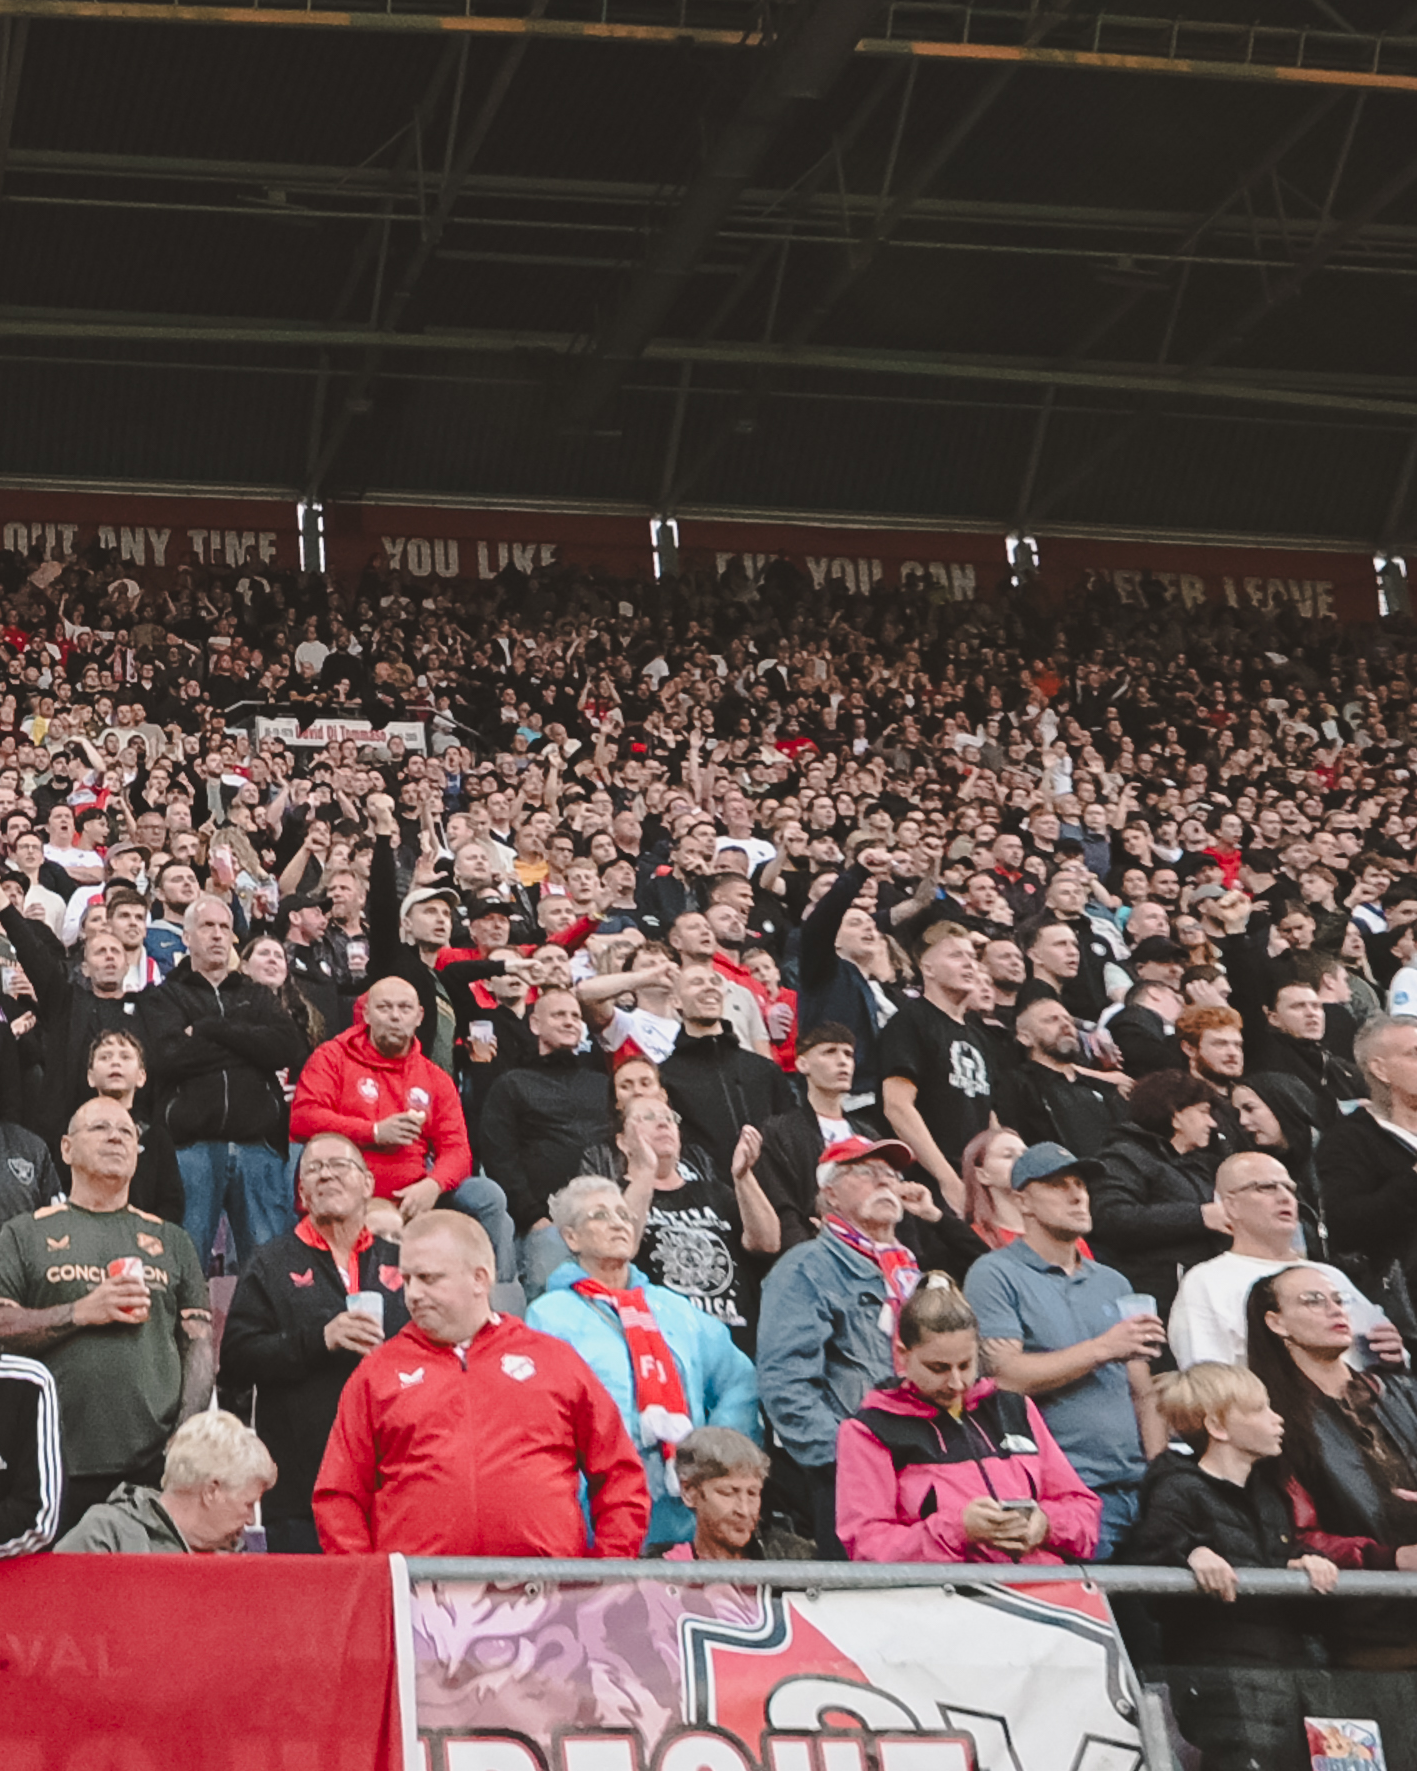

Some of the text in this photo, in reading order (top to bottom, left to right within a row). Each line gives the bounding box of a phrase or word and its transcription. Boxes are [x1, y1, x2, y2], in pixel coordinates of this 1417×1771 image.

[381, 535, 460, 579] YOU
[1085, 567, 1207, 613] EER
[46, 1263, 169, 1286] CONCLON
